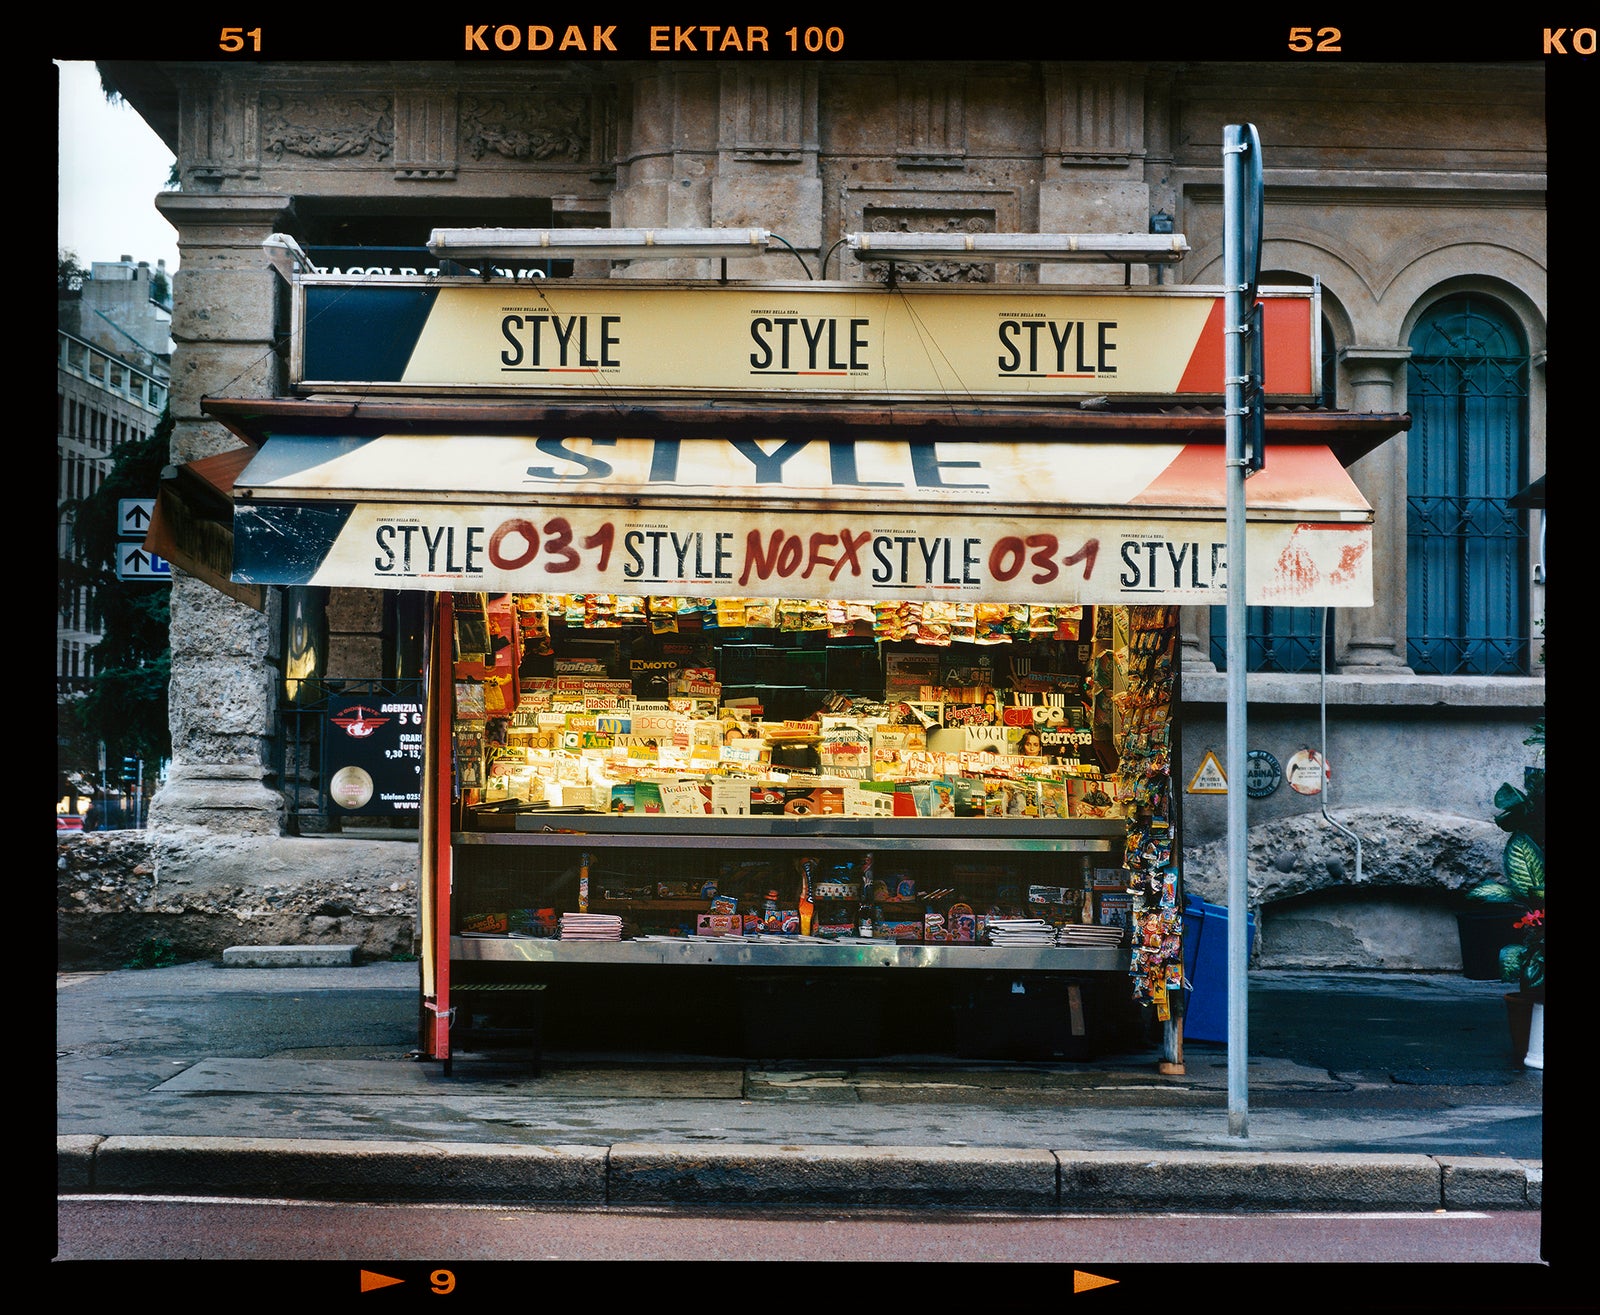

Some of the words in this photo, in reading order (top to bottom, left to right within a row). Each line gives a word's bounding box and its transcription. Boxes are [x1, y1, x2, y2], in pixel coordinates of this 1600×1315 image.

[501, 315, 621, 367] STYLE
[750, 317, 870, 370] STYLE
[998, 320, 1118, 373] STYLE
[374, 525, 485, 572] STYLE
[488, 517, 615, 574] 031
[624, 530, 734, 578] STYLE
[738, 528, 872, 587] NOFX
[872, 536, 982, 584] STYLE
[988, 533, 1099, 585] 031
[381, 704, 417, 713] AGENZIA
[399, 713, 408, 724] 5
[600, 720, 622, 733] AD
[1033, 707, 1066, 722] GQ
[385, 751, 403, 759] 9,30
[1247, 770, 1272, 778] ABINA
